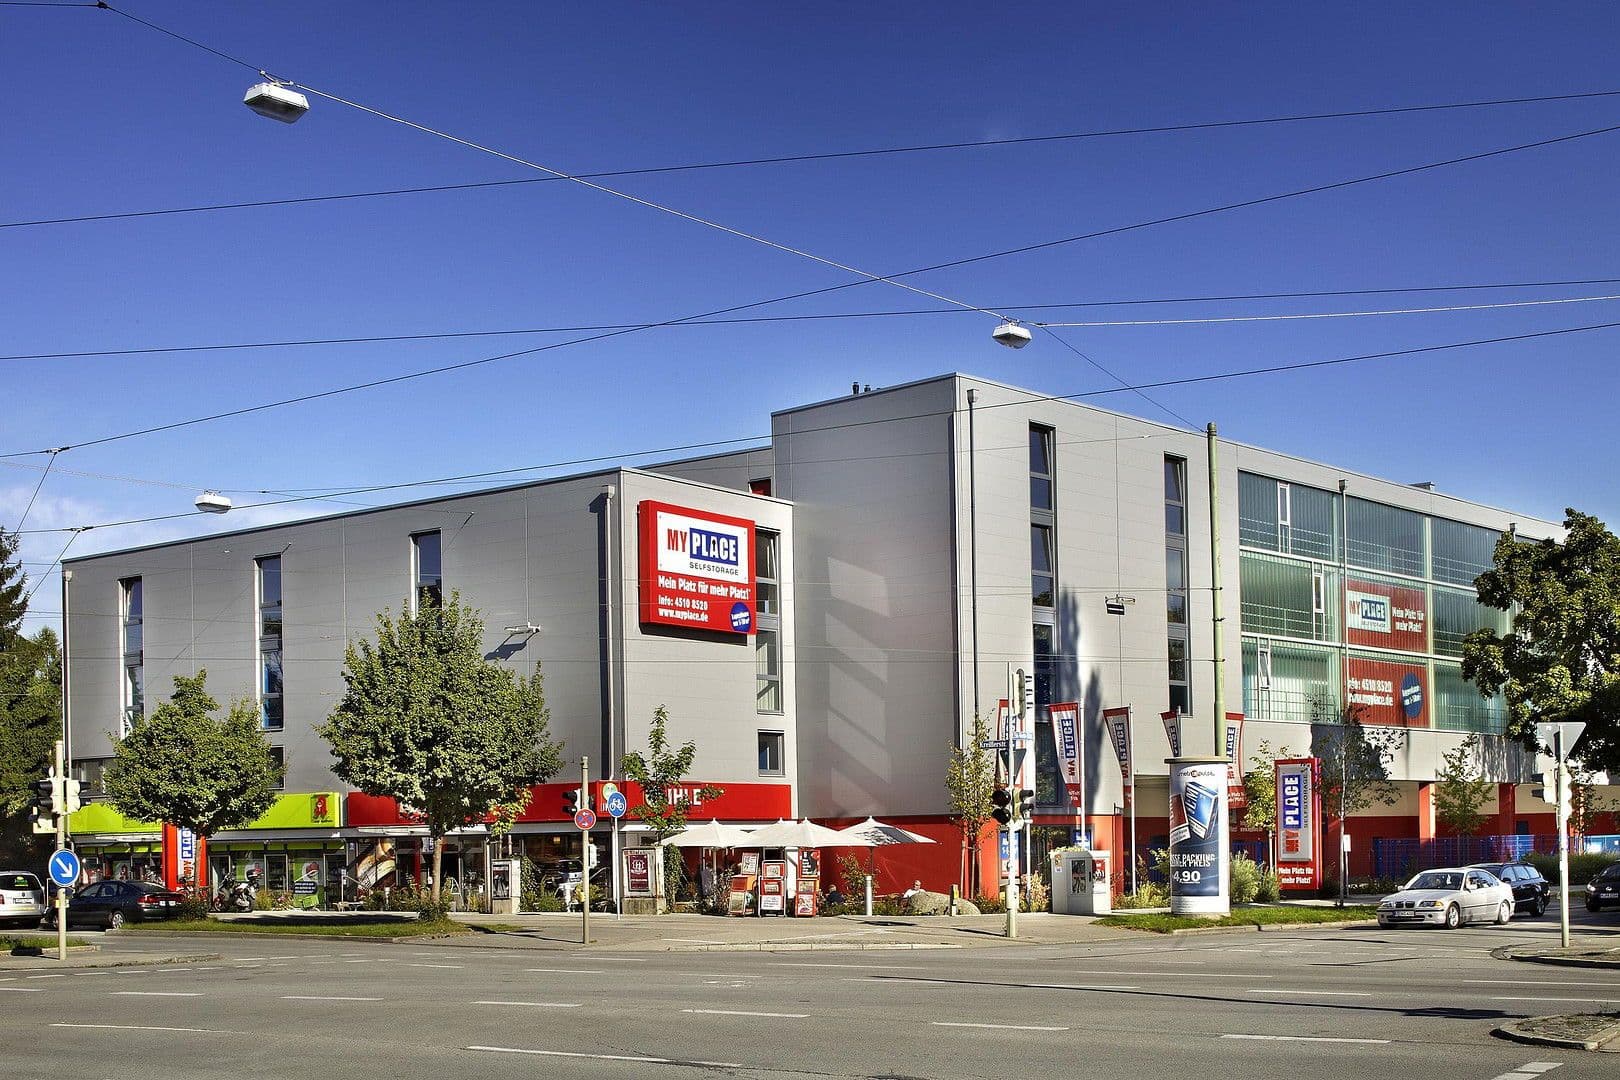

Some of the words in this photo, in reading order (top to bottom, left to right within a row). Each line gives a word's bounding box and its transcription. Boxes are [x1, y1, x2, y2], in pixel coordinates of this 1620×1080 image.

[667, 528, 687, 552] MY
[691, 532, 737, 562] PLACE
[689, 561, 739, 576] SELFSTORAGE
[658, 575, 677, 590] Mein
[678, 578, 697, 593] Platz
[698, 581, 709, 594] für
[709, 584, 729, 598] mehr
[658, 595, 674, 606] Info:
[674, 597, 690, 609] 4510
[691, 600, 708, 611] 8520
[1362, 602, 1385, 619] PLACE
[658, 608, 709, 622] www.myplace.de
[1285, 776, 1299, 825] PLACE
[1285, 829, 1299, 853] MY
